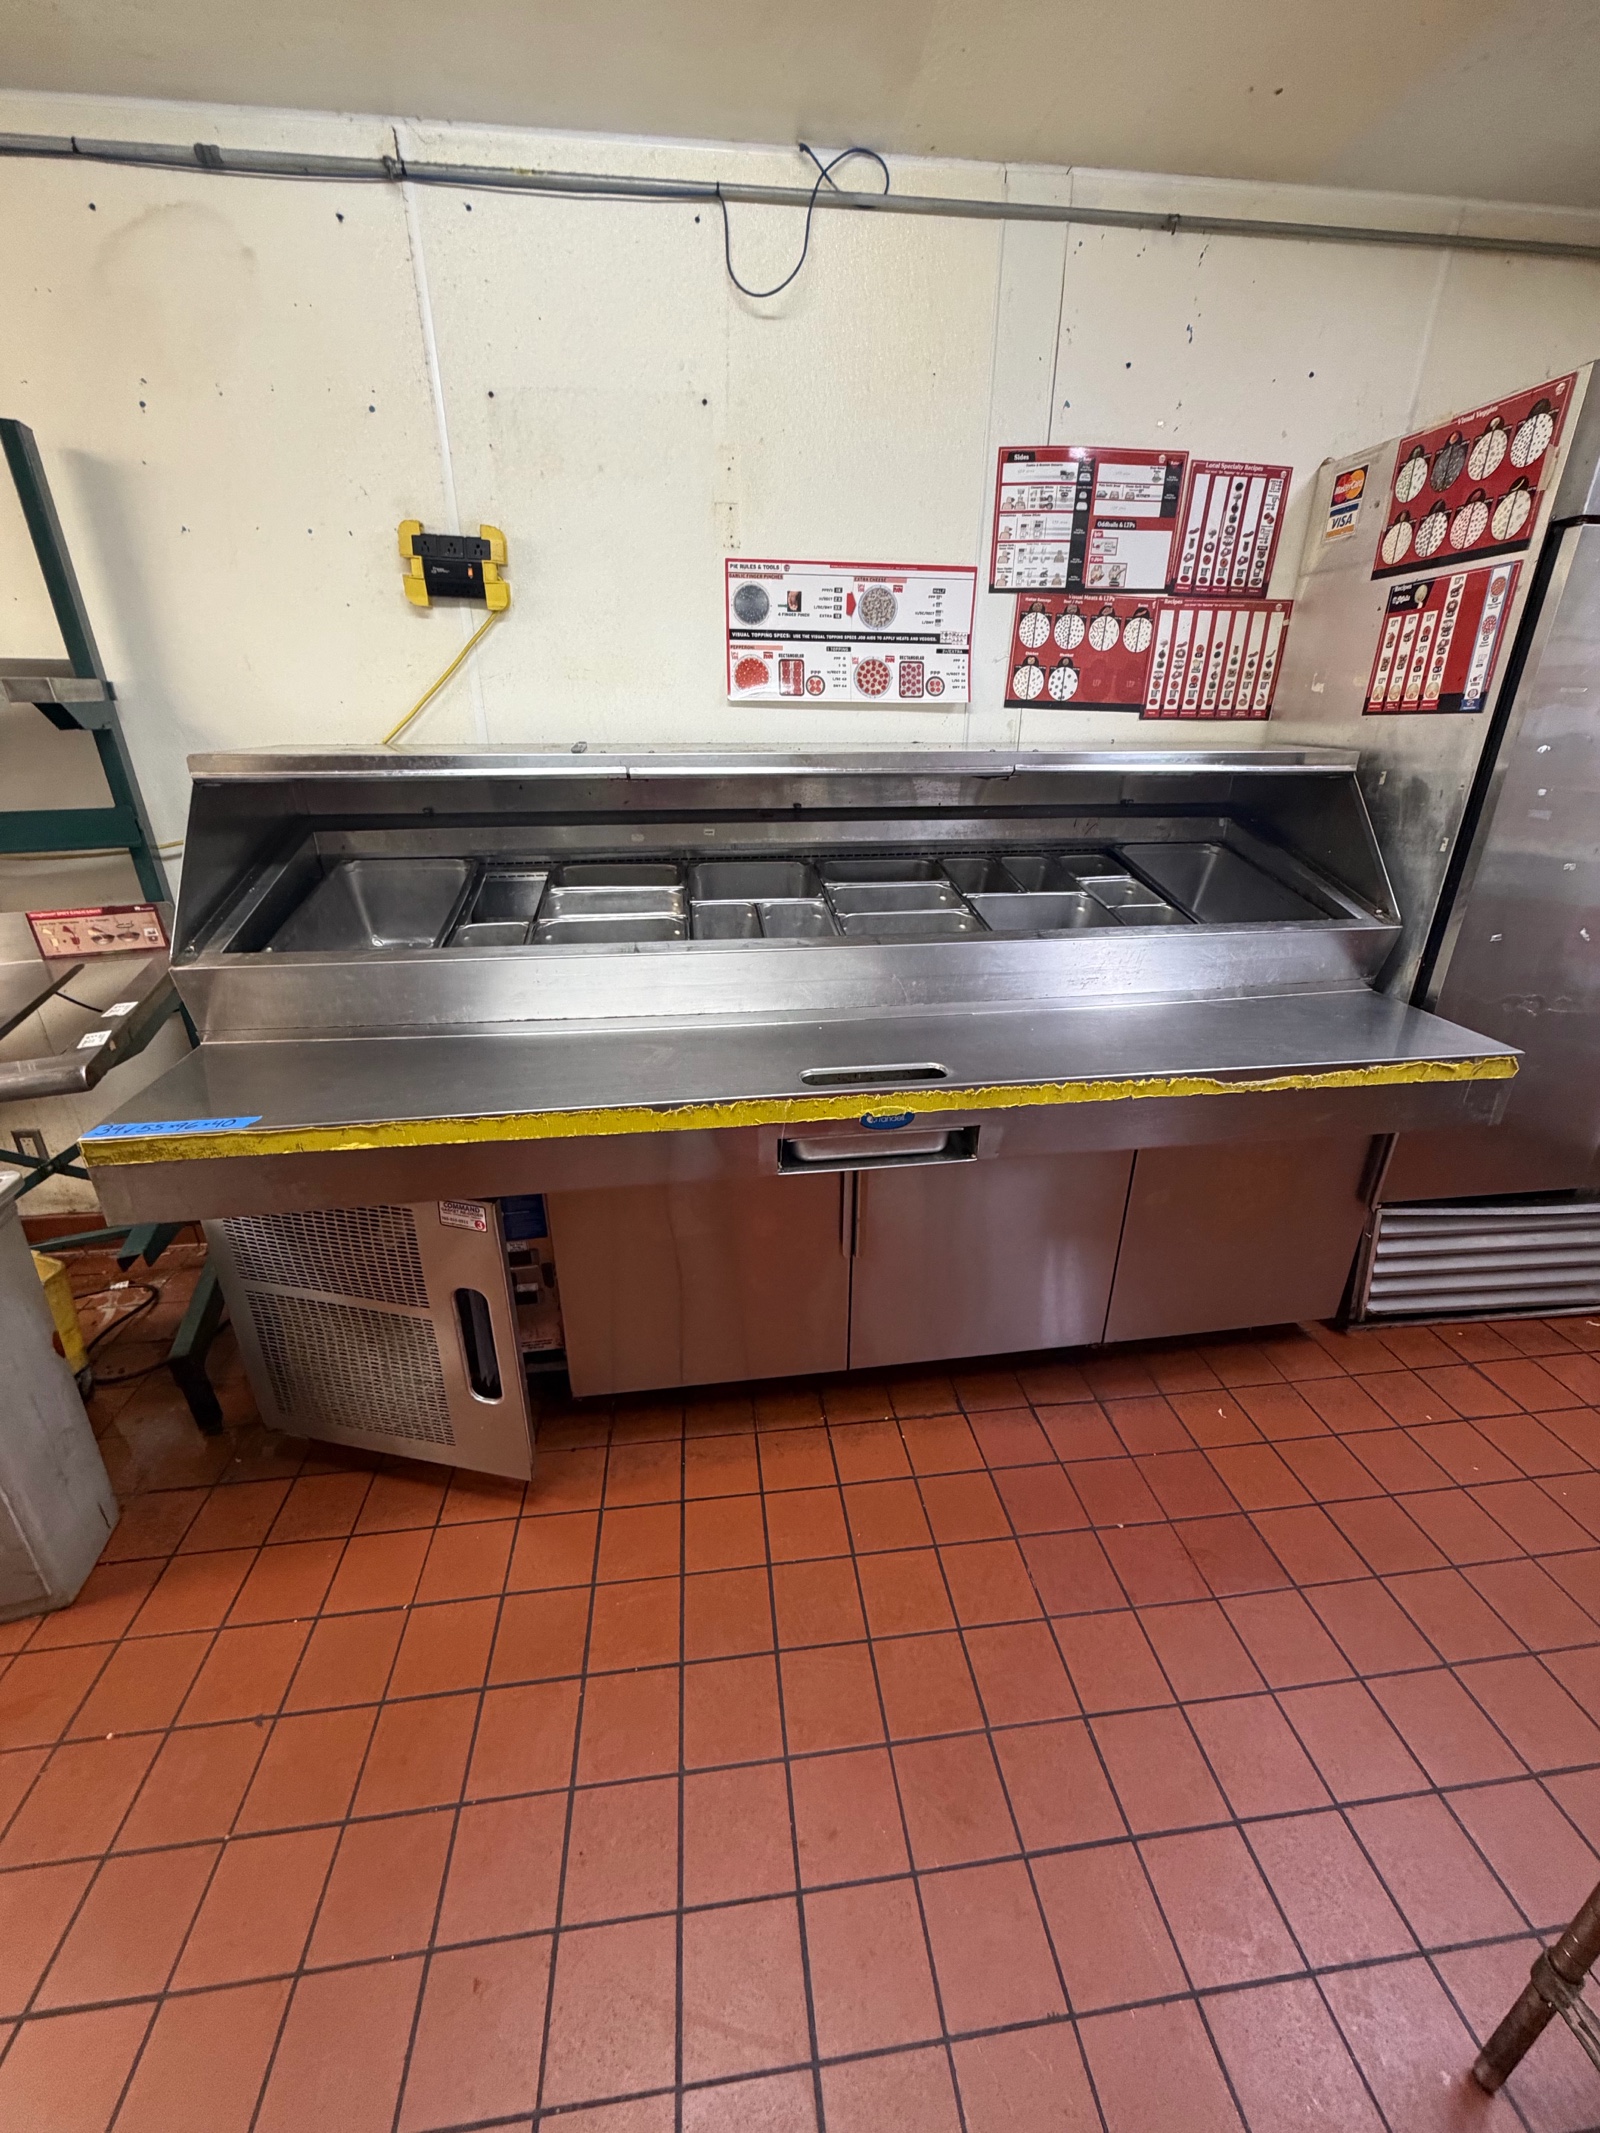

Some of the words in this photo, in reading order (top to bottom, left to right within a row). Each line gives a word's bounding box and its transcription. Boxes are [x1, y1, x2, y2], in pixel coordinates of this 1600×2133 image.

[1332, 514, 1352, 529] VISA
[443, 1202, 480, 1213] COMMAND
[477, 1221, 483, 1229] 3
